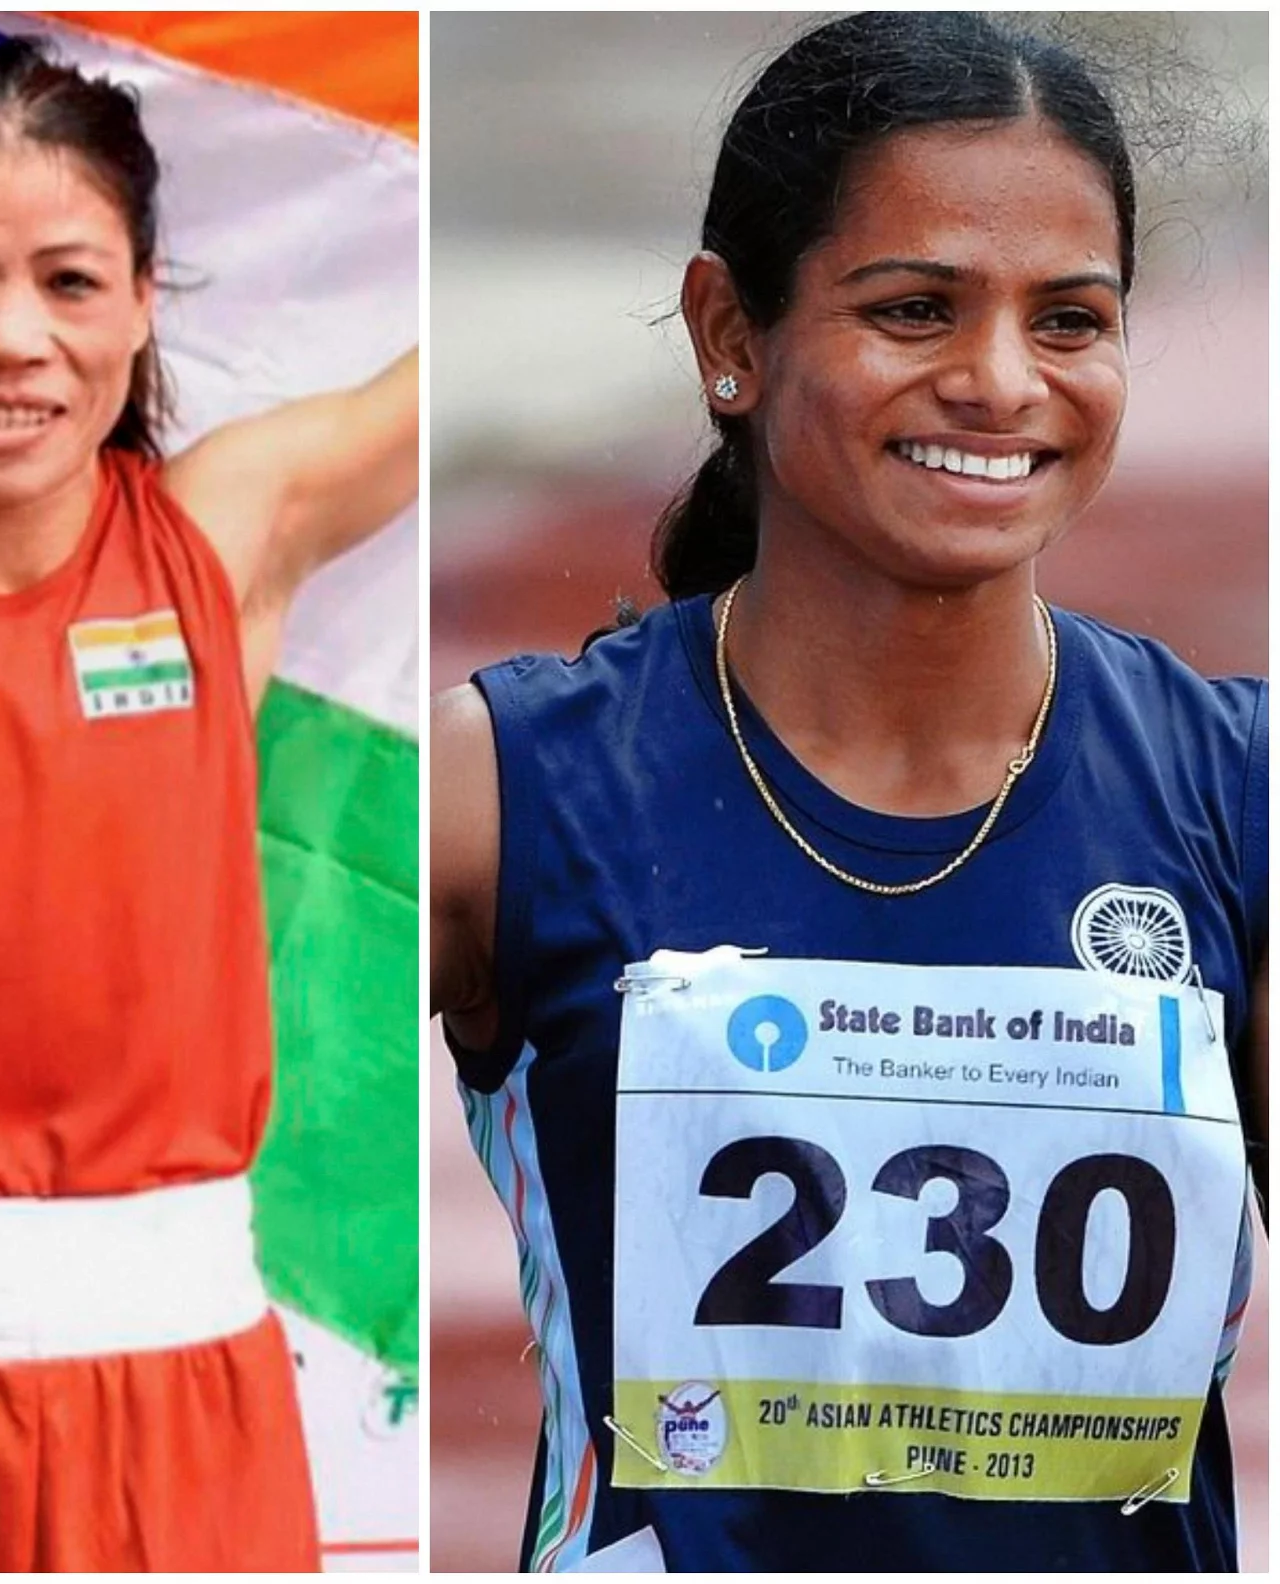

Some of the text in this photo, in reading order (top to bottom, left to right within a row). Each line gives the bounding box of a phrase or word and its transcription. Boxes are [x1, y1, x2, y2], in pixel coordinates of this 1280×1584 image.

[819, 999, 1135, 1046] State Bank of India
[833, 1056, 1119, 1089] The Banker to Every Indian
[694, 1136, 1176, 1346] 230
[806, 1402, 871, 1428] ASIAN
[879, 1403, 1002, 1436] ATHLETICS
[1009, 1412, 1182, 1441] CHAMPIONSHIPS
[907, 1446, 967, 1474] PUNE
[986, 1453, 1035, 1478] 2013
